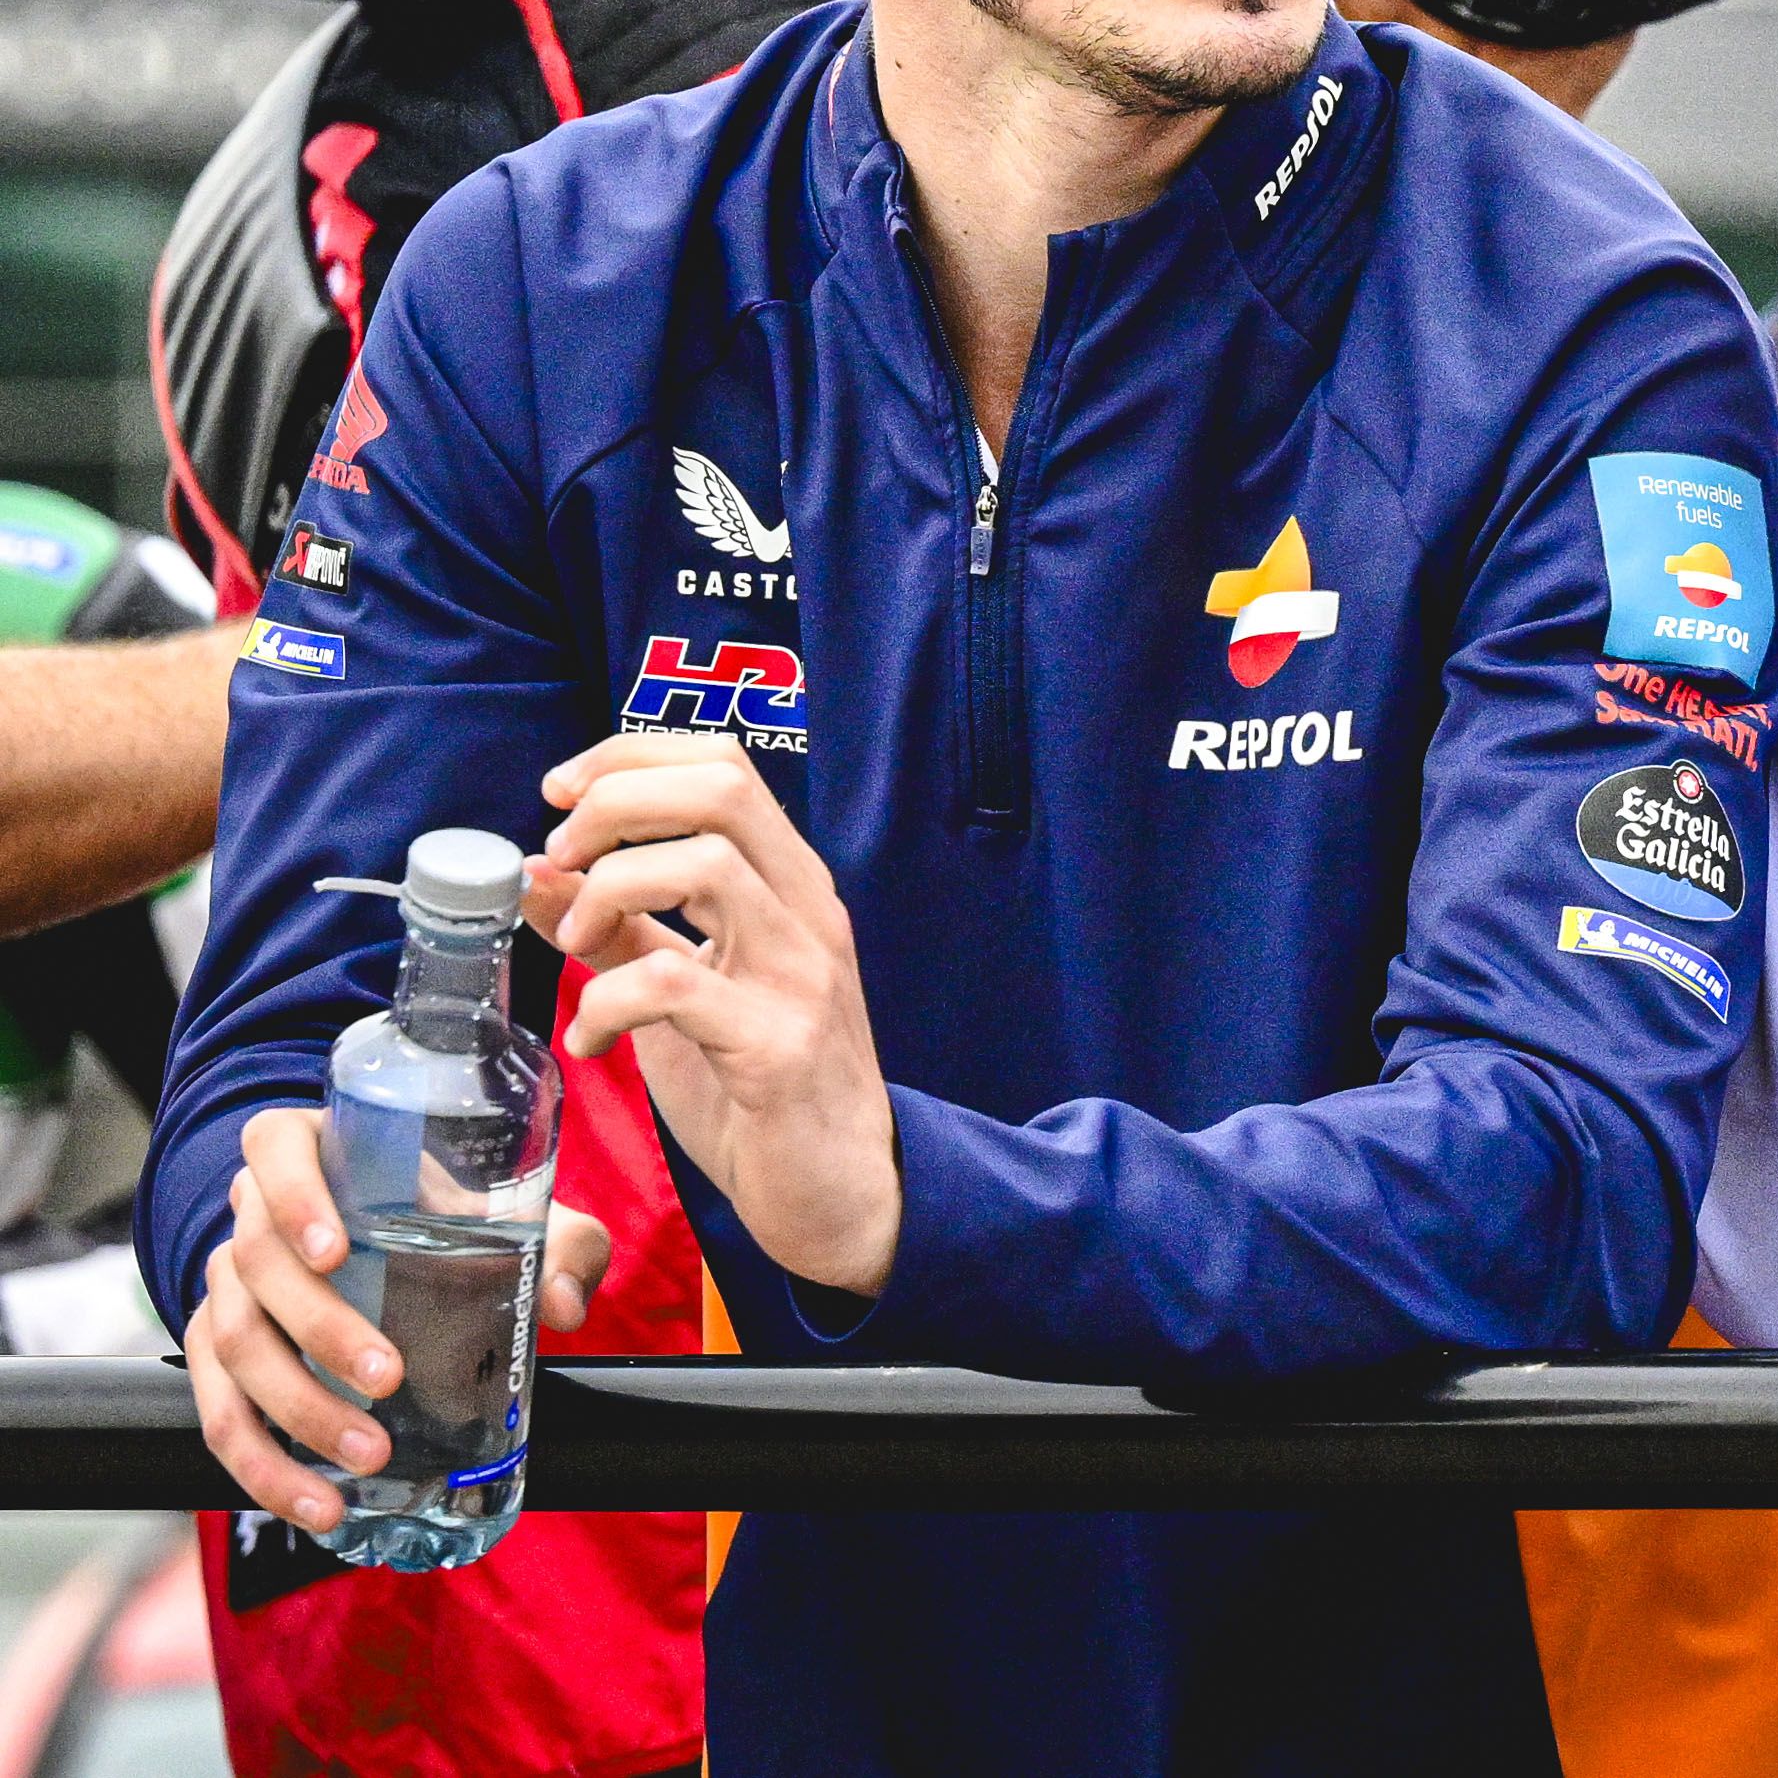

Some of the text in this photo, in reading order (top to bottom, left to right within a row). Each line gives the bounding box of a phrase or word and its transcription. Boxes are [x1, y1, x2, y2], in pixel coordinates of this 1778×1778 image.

[1254, 74, 1344, 221] REPSOL
[1638, 475, 1743, 510] Renewable
[1676, 500, 1723, 529] fuels
[1653, 614, 1750, 654] REPSOL
[1168, 710, 1363, 771] REPSOL
[1615, 785, 1731, 862] Estrella
[1617, 822, 1726, 894] Galicia
[1623, 932, 1725, 1001] MICHELIN
